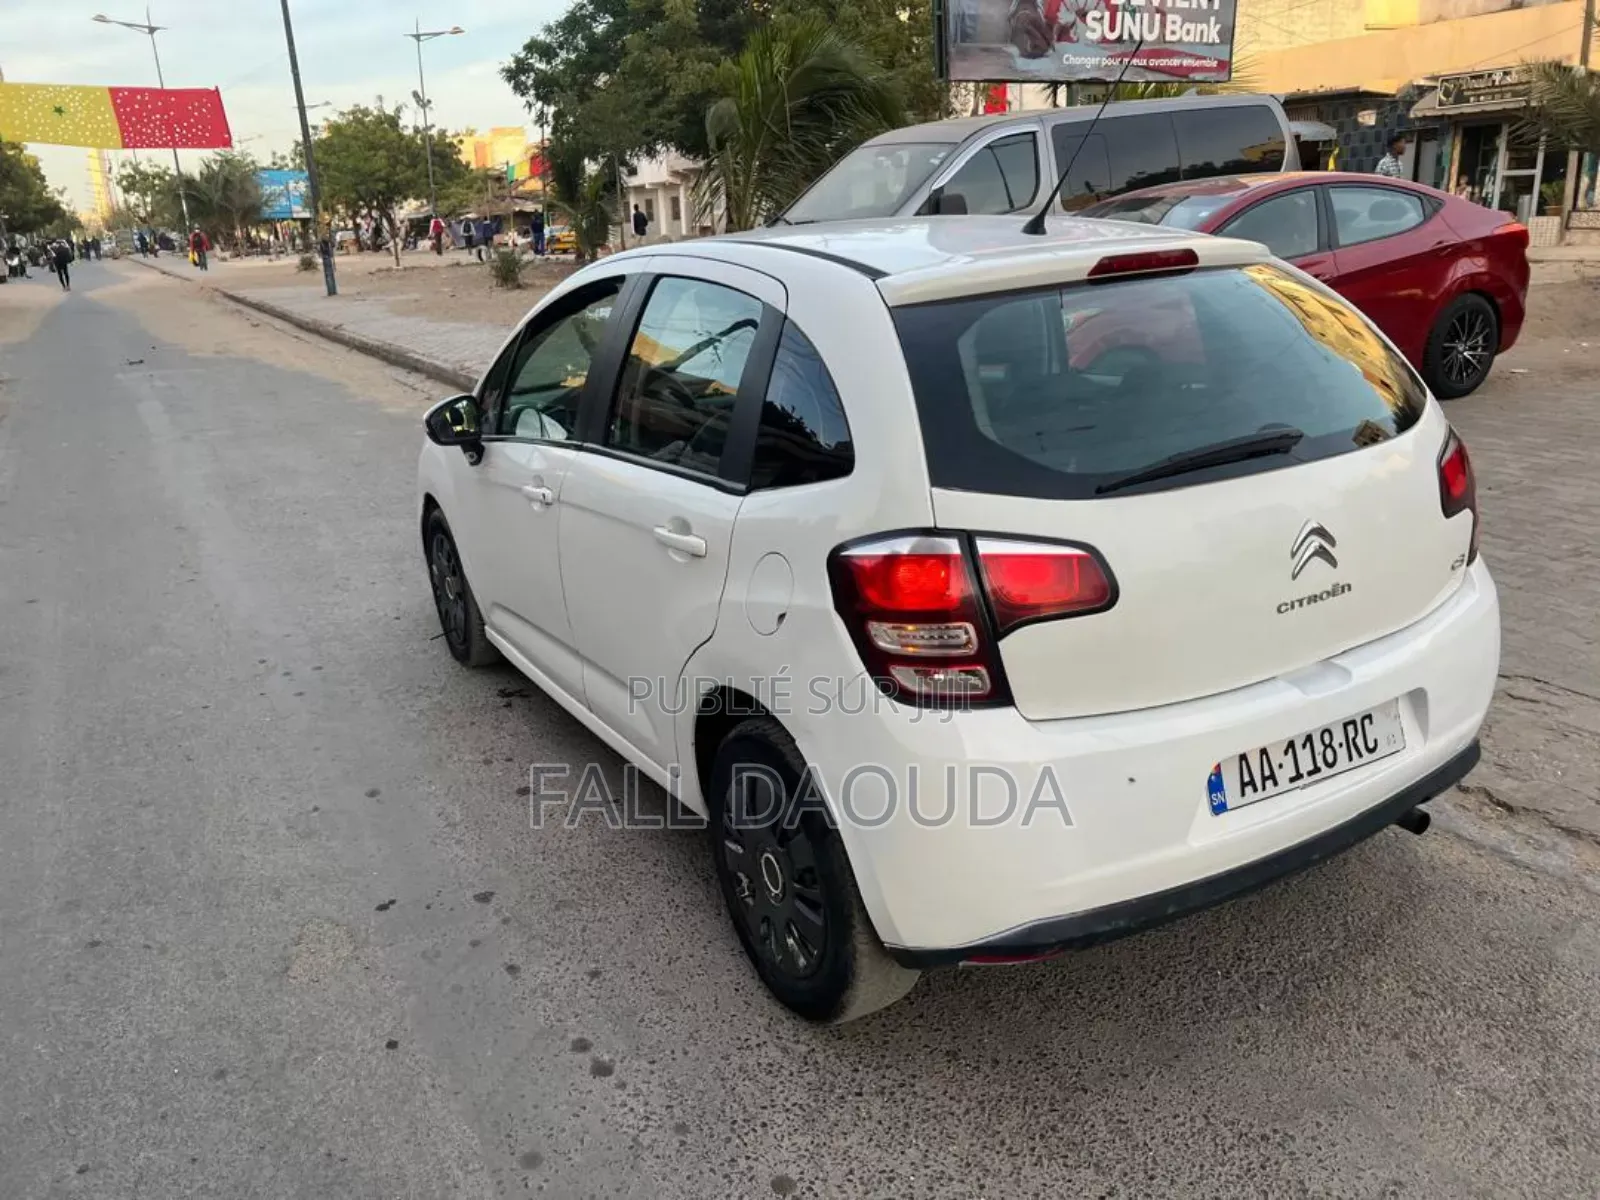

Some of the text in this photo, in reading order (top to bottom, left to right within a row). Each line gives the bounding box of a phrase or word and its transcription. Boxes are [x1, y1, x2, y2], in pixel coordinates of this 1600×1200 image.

[1085, 10, 1221, 43] SUNU Bank
[1063, 54, 1099, 68] Changer
[1102, 56, 1121, 67] pour
[1149, 57, 1181, 66] avancer
[1182, 57, 1218, 68] ensemble
[1211, 790, 1225, 806] SN
